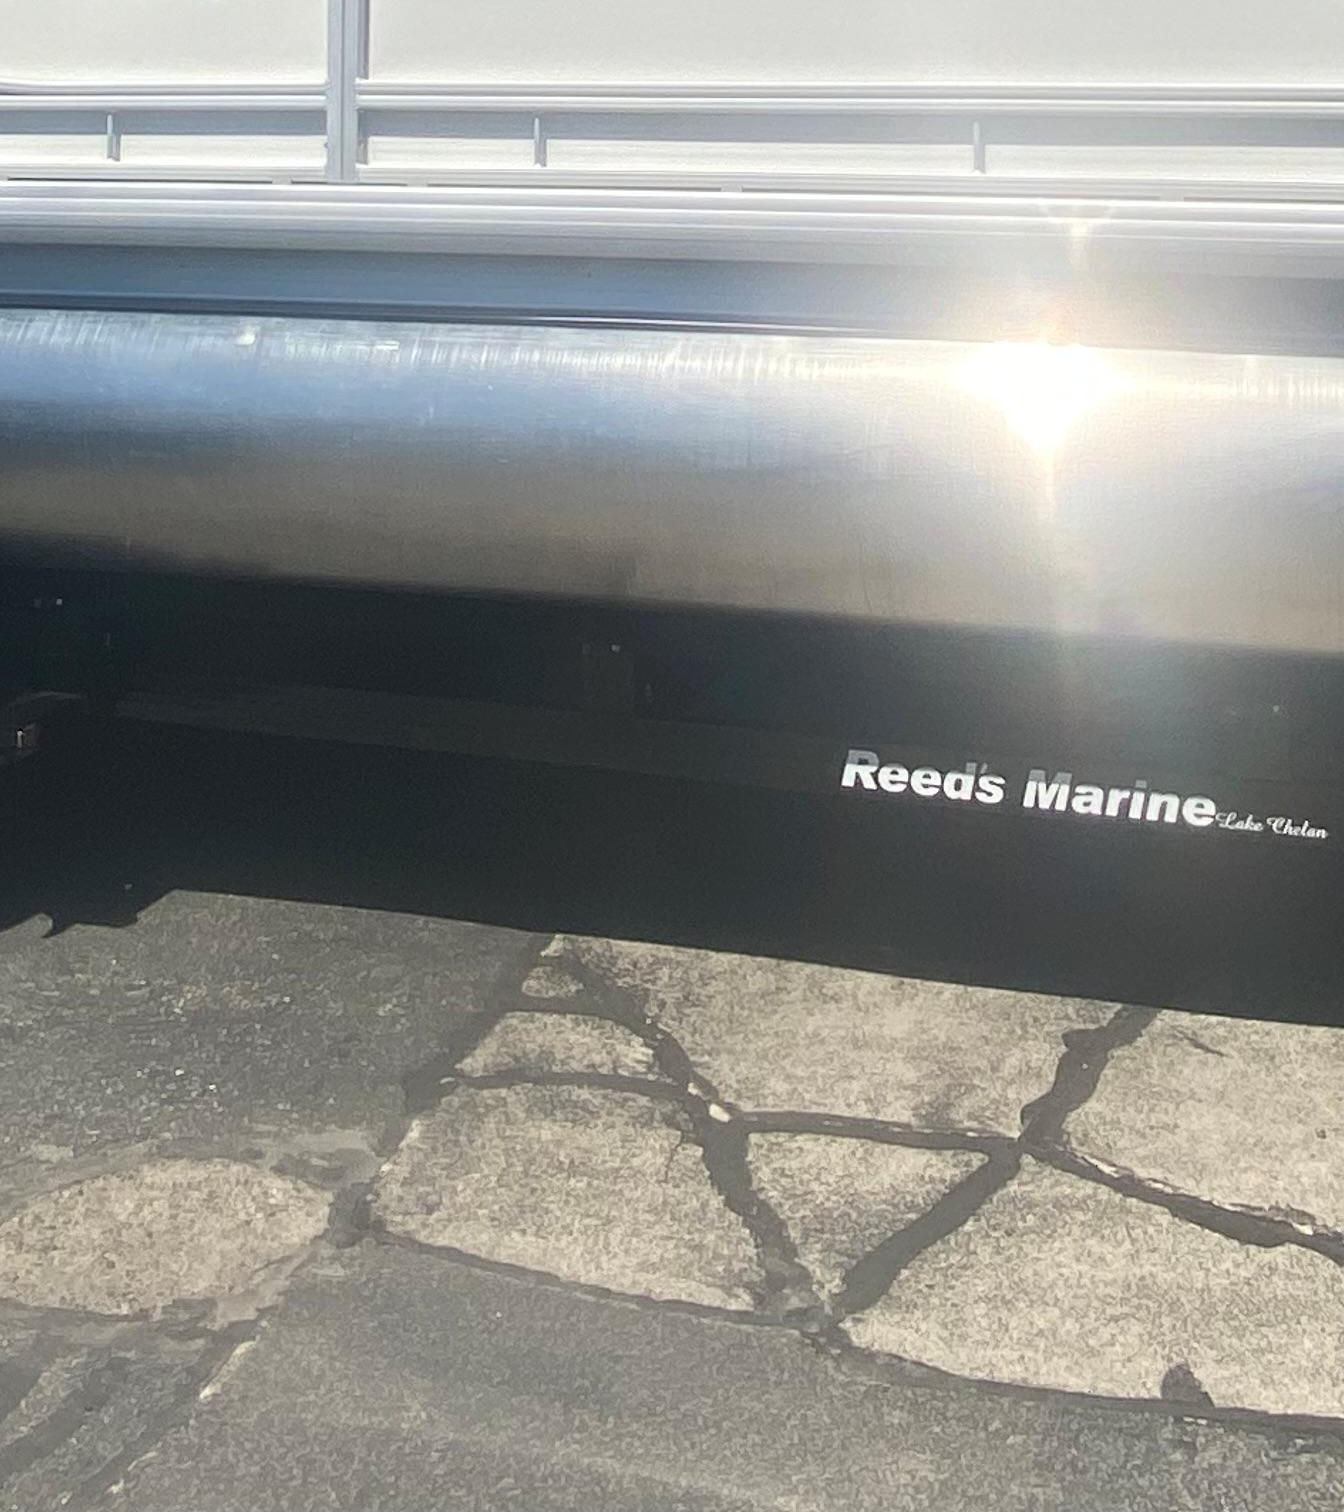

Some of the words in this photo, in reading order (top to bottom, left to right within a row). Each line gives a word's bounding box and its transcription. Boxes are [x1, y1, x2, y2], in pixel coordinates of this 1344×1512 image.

[841, 749, 1006, 804] Reed's
[1022, 769, 1216, 827] Marine
[1215, 811, 1264, 832] Lake
[1266, 816, 1329, 839] Chelan
